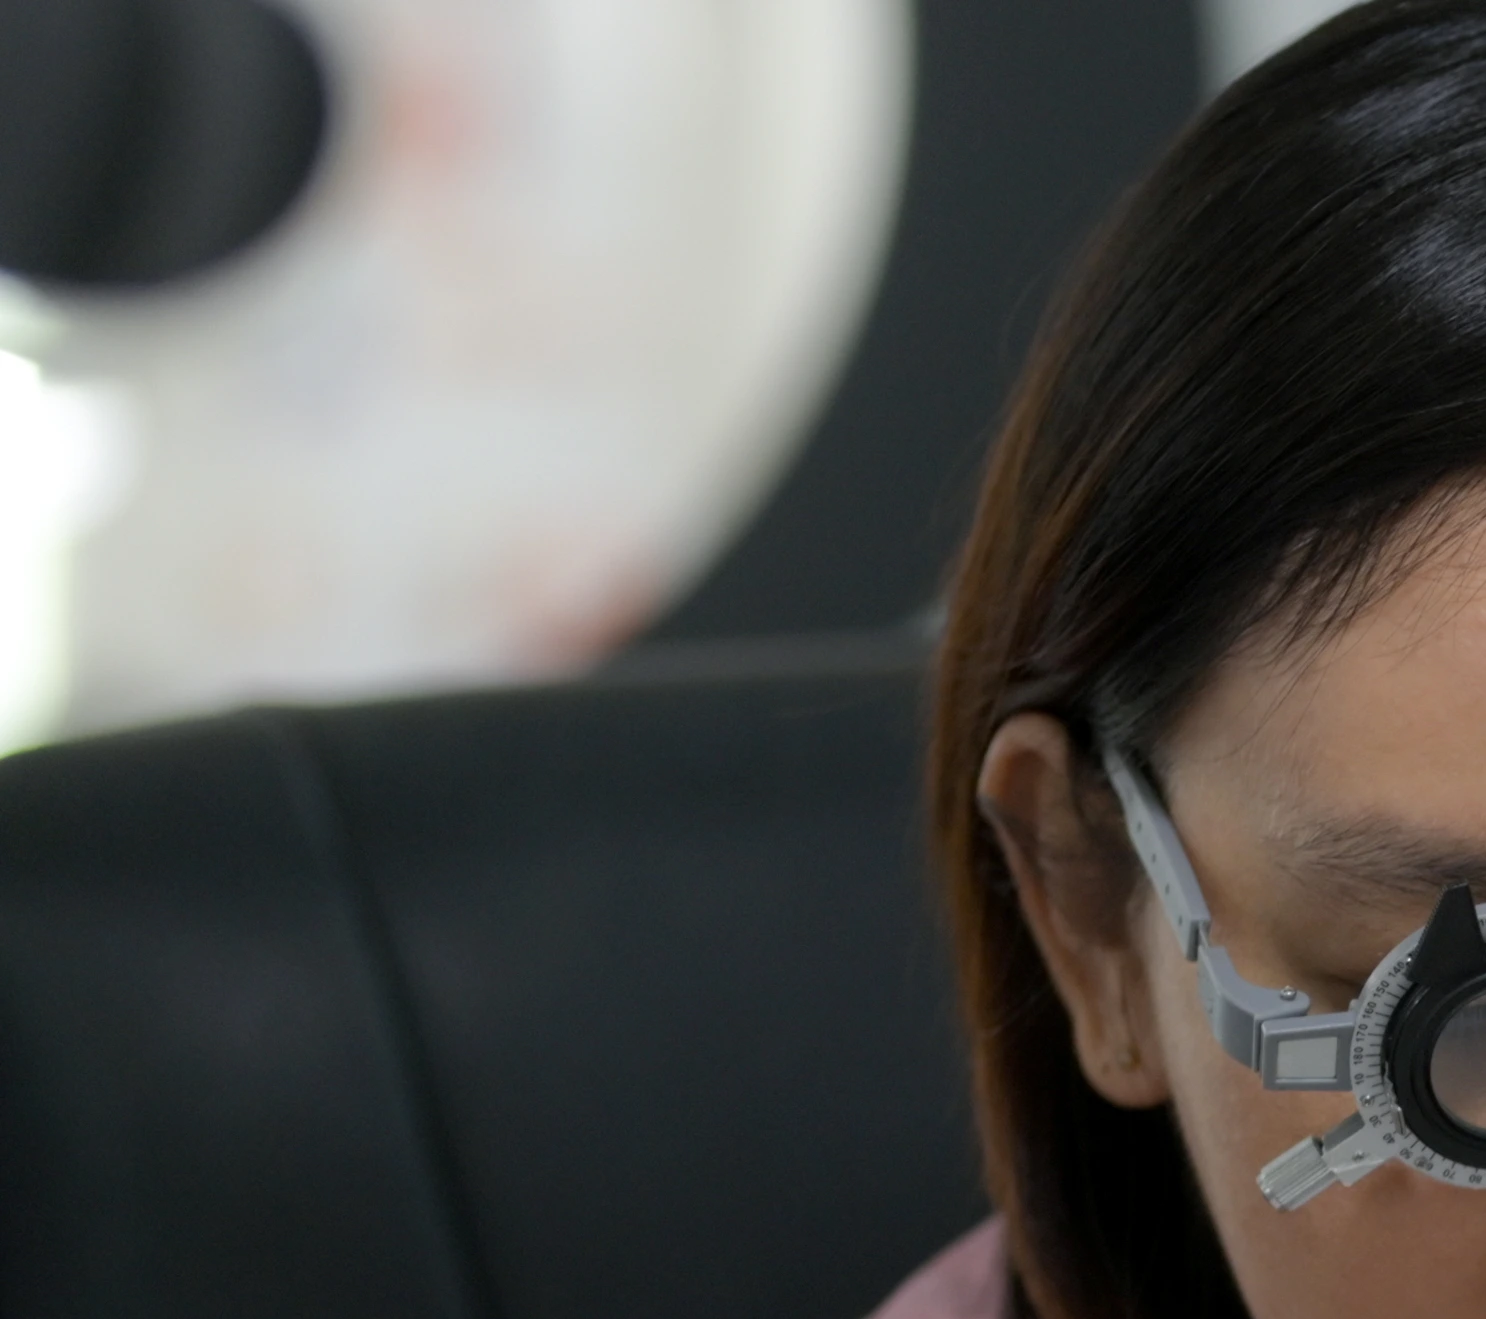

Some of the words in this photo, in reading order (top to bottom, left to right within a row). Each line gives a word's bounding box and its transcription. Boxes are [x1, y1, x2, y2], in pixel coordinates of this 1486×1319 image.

[1388, 960, 1406, 979] 140
[1373, 979, 1390, 998] 150
[1362, 1001, 1377, 1019] 160
[1356, 1023, 1368, 1042] 170
[1353, 1046, 1364, 1066] 180
[1354, 1073, 1365, 1085] 10
[1369, 1114, 1383, 1128] 30
[1442, 1168, 1456, 1180] 70
[1469, 1173, 1483, 1184] 80
